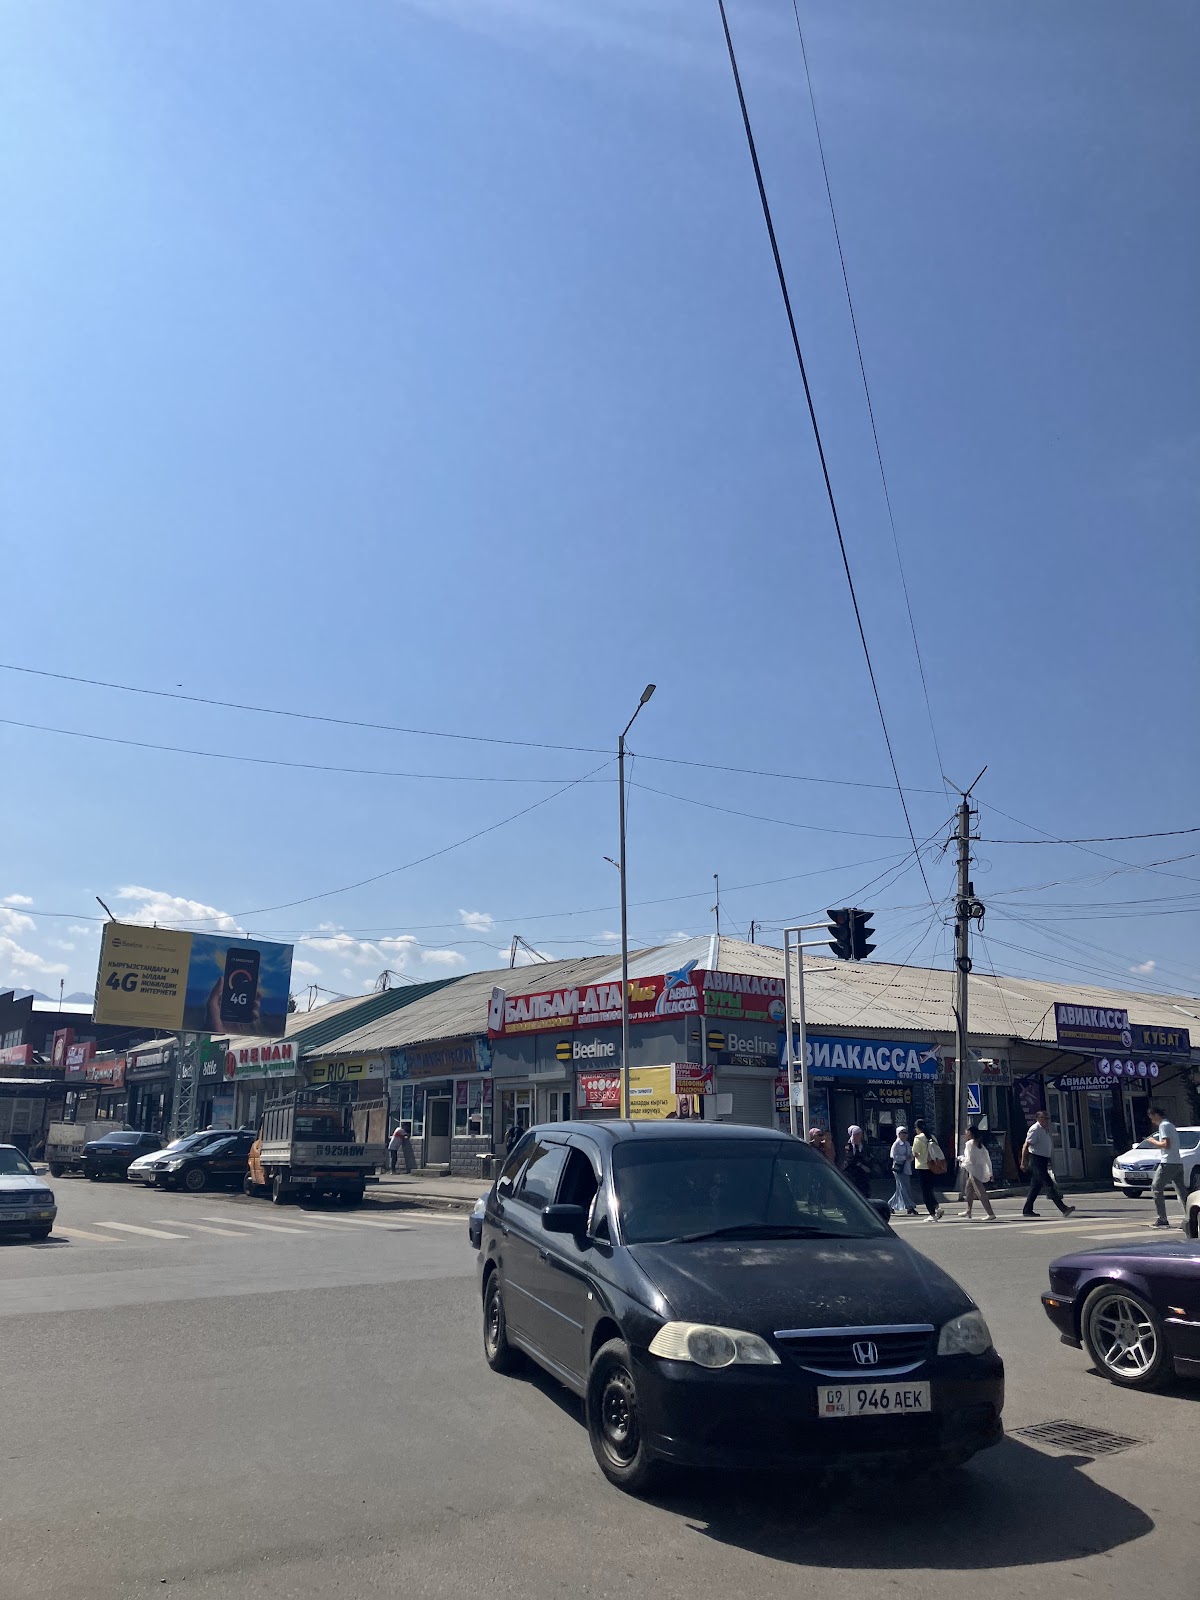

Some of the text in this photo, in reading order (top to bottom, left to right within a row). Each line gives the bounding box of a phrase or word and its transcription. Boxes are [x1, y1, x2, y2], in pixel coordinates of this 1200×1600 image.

[122, 940, 143, 949] Beeline
[105, 971, 139, 992] 4G
[142, 972, 167, 981] ЫЛДАМ
[703, 971, 785, 997] АВИАКАССА
[140, 987, 177, 996] ИНТЕРНЕТИ
[229, 993, 248, 1005] 4G
[669, 985, 699, 1001] АВИА
[703, 990, 742, 1008] ТУРЫ
[504, 984, 622, 1023] БАЛБАЙ-АТА
[664, 999, 699, 1014] КАССА
[1058, 1006, 1132, 1030] АВИАКАССА
[727, 1033, 777, 1054] Beeline
[1144, 1031, 1181, 1047] КУБАТ
[573, 1037, 615, 1059] Beeline
[730, 1057, 767, 1067] ESSENS
[780, 1041, 921, 1073] АВИАКАССА
[327, 1062, 346, 1082] RIO
[1060, 1076, 1120, 1087] АВИАКАССА
[879, 1088, 904, 1097] КОФЕ
[826, 1390, 842, 1404] 09
